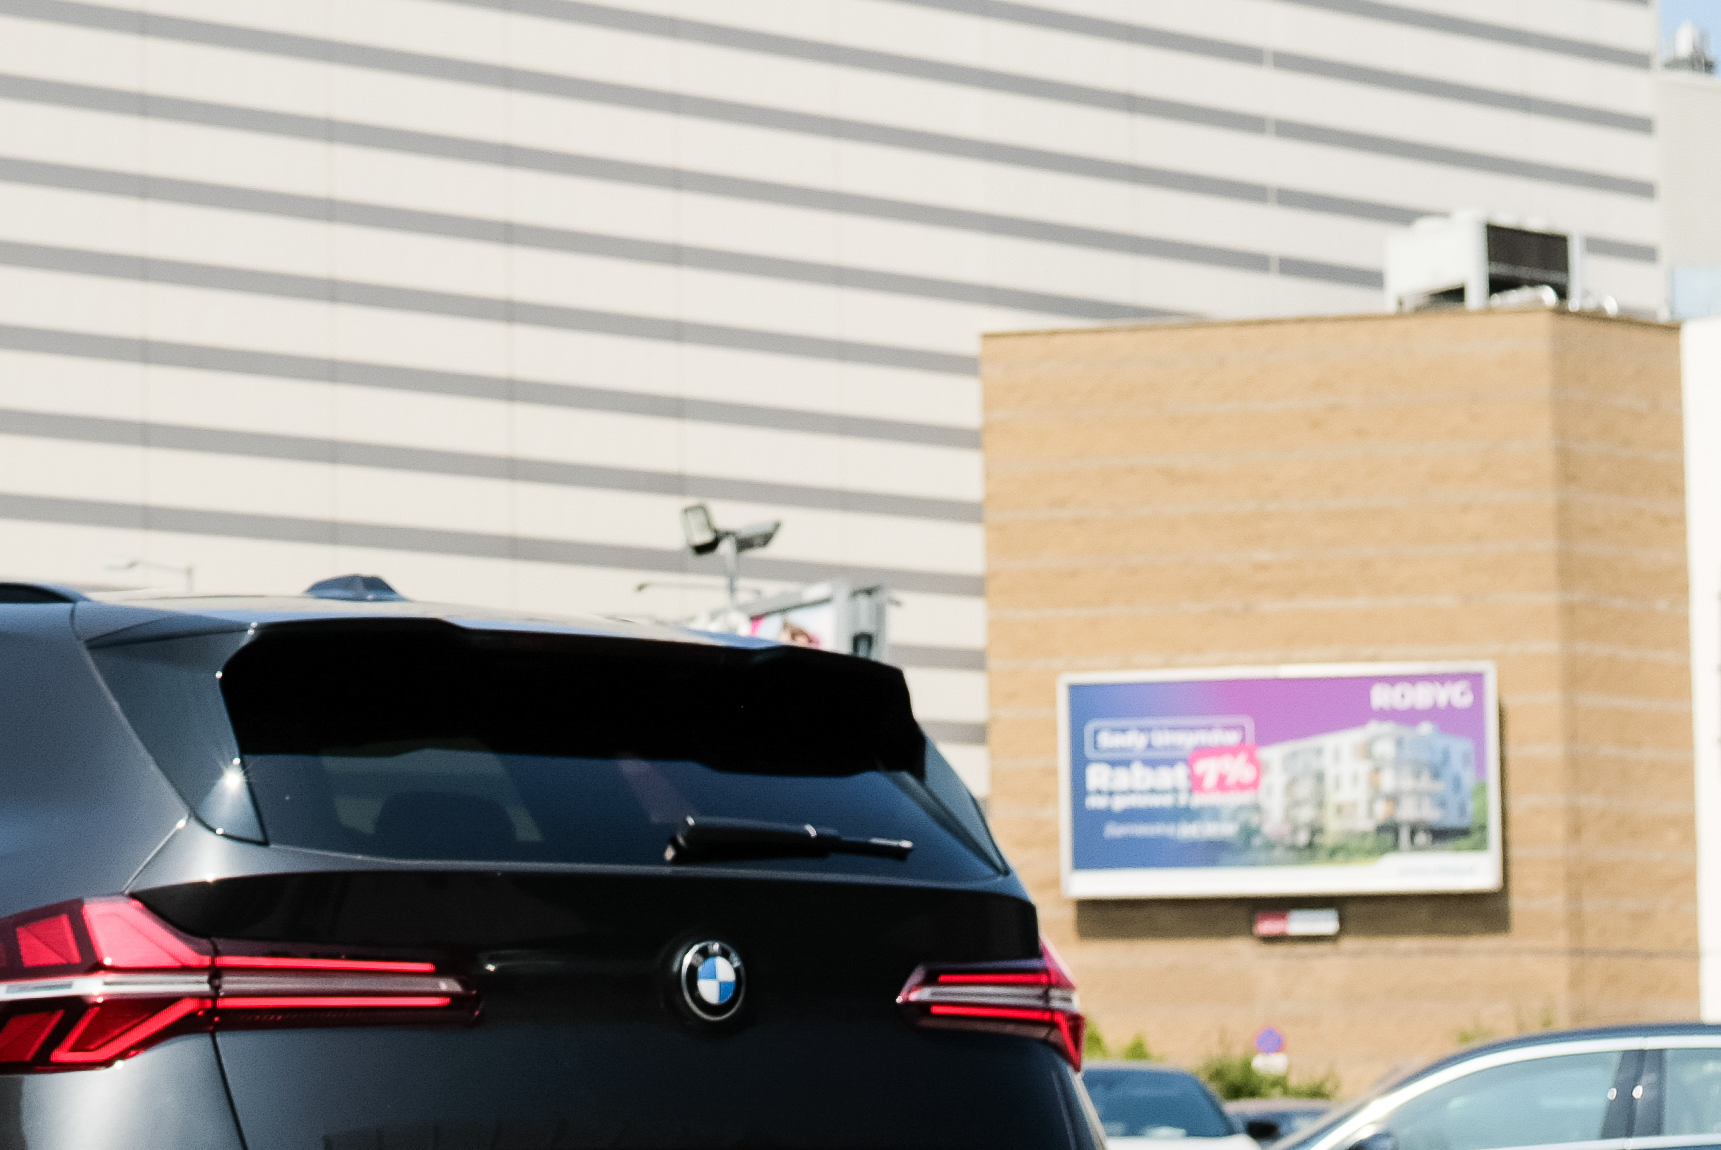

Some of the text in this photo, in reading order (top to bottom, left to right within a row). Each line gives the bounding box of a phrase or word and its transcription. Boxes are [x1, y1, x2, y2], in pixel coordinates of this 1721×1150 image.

[1370, 681, 1474, 710] ROBYG
[1086, 753, 1258, 791] Rabat 7%
